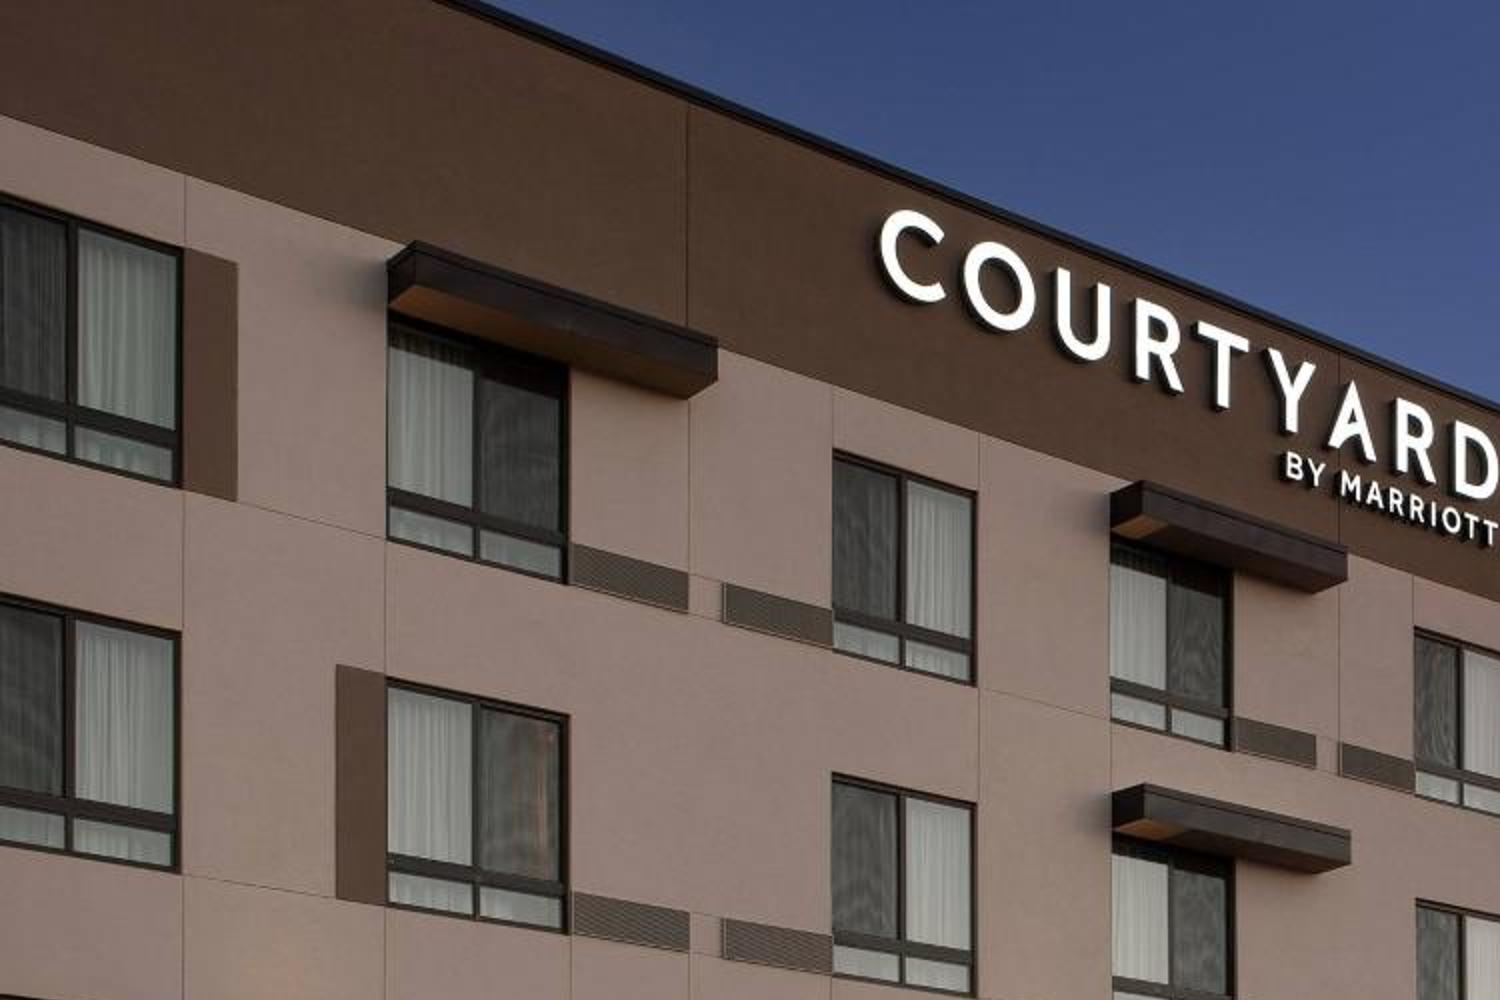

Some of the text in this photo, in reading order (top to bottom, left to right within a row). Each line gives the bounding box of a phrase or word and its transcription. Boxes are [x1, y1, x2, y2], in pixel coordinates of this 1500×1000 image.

[878, 208, 1500, 500] COURTYARD
[1286, 451, 1500, 546] BY MARRIOTT
